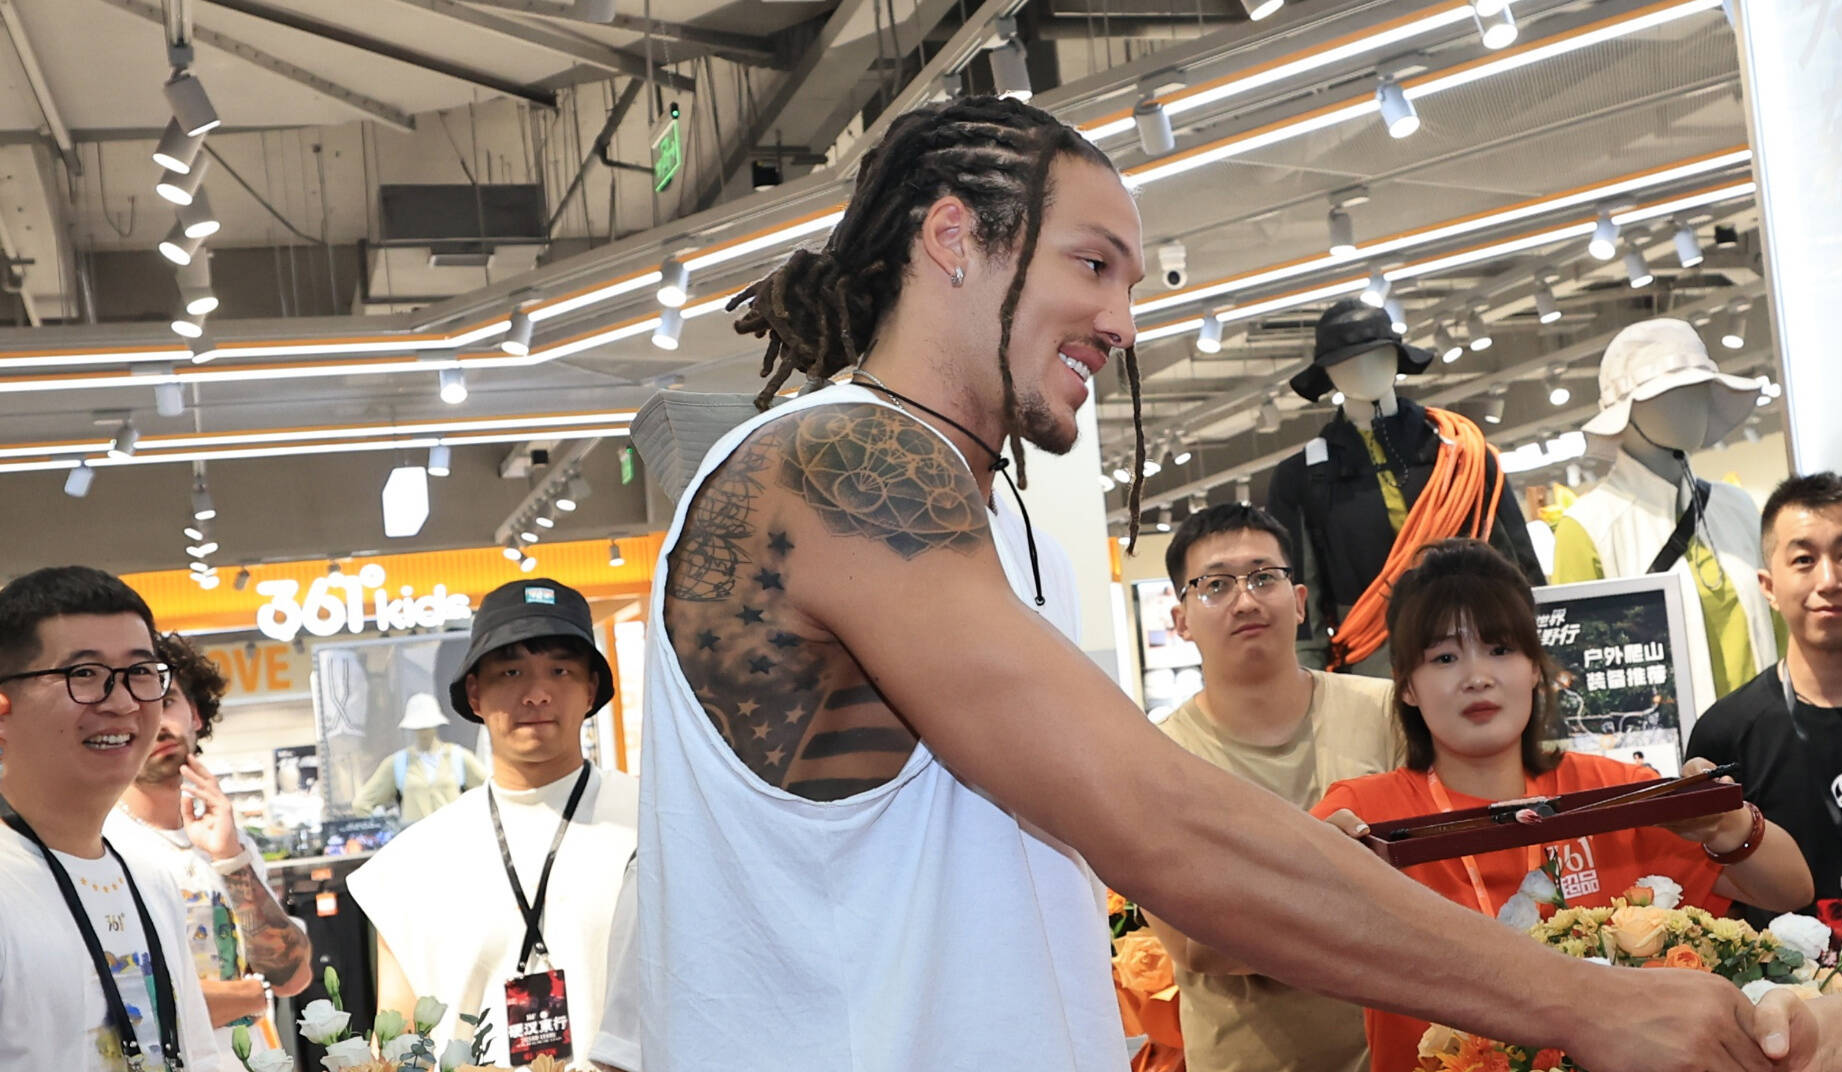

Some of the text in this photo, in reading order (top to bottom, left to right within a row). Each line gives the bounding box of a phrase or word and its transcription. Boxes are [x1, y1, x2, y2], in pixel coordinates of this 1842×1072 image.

[256, 563, 473, 642] 361° kids
[1536, 623, 1581, 647] 野行
[1584, 641, 1665, 669] 户外爬山
